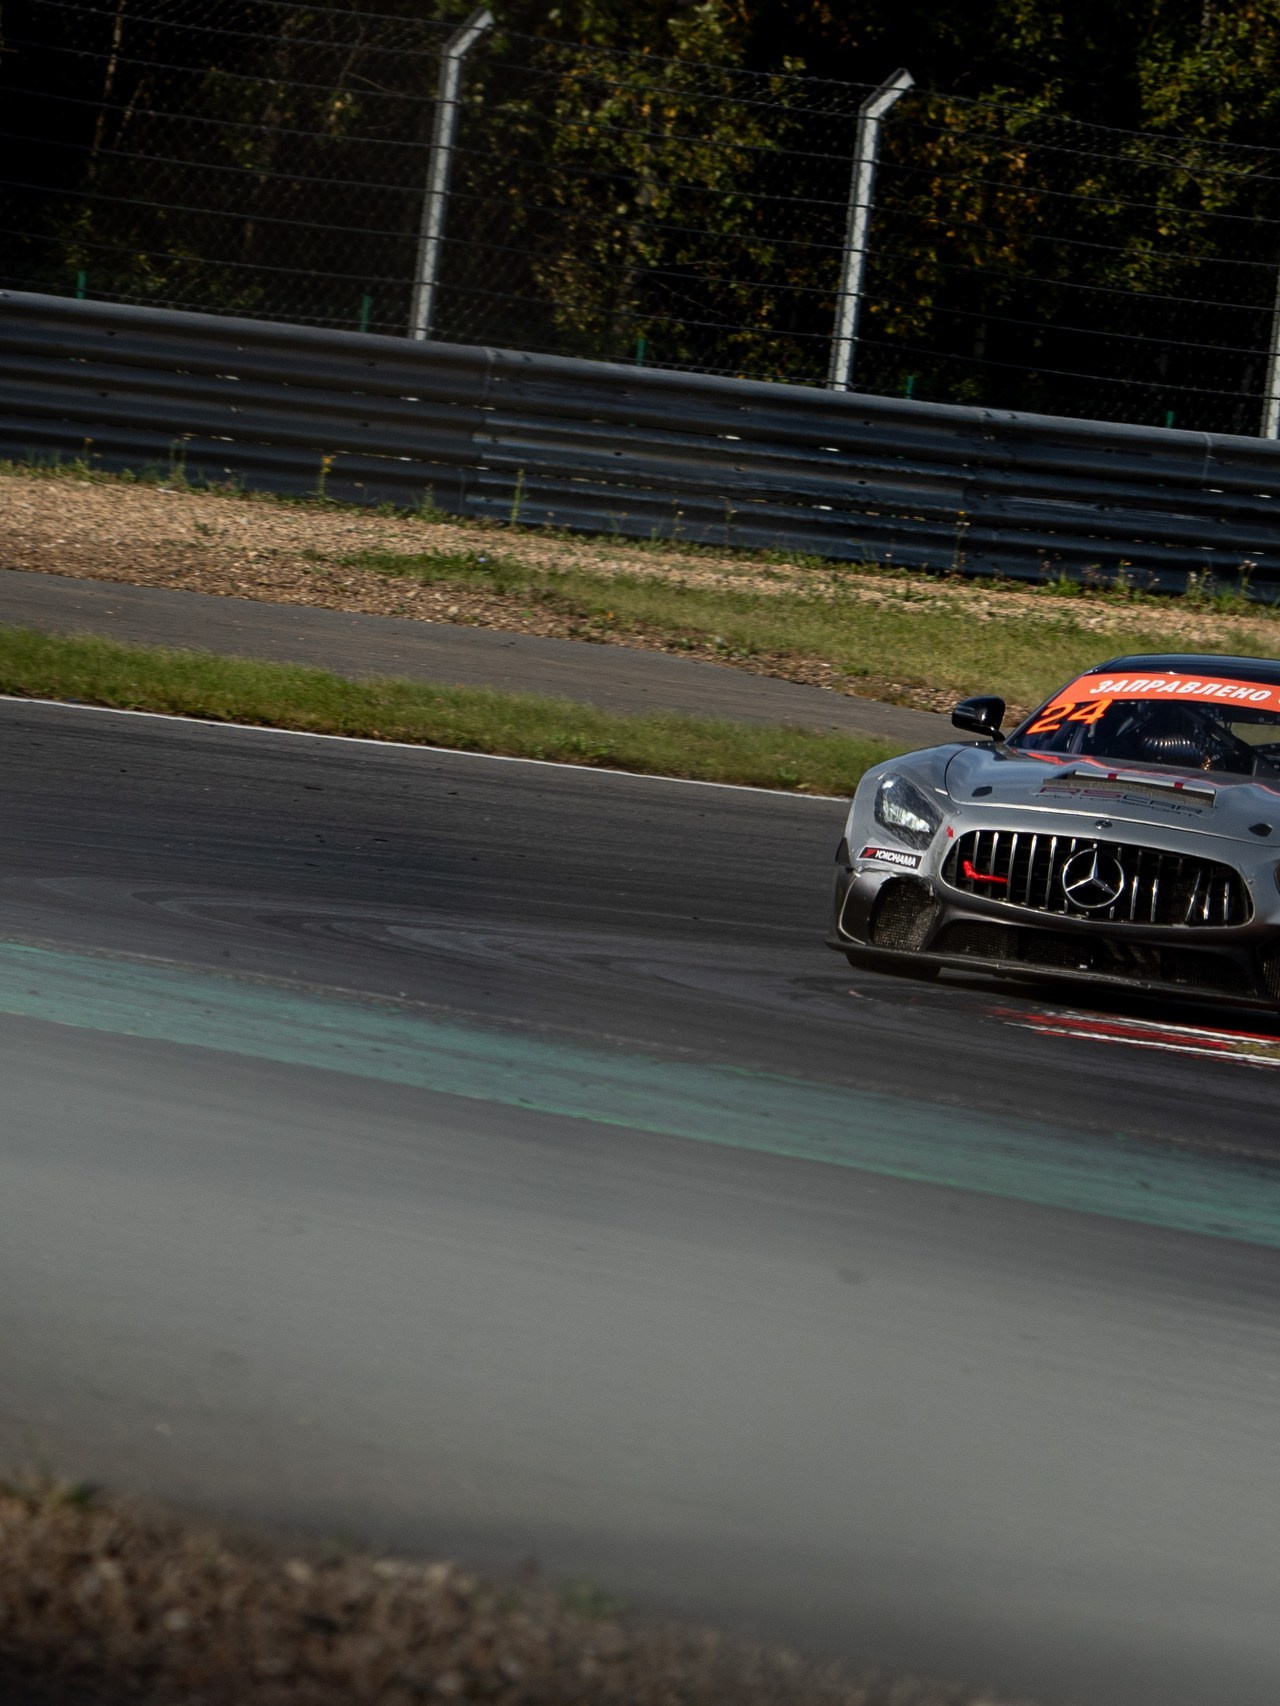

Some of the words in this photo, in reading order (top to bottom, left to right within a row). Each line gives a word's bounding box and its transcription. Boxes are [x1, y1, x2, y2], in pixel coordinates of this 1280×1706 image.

[1089, 680, 1272, 701] ЗАПРАВЛЕНО
[1026, 699, 1112, 734] 24
[875, 850, 916, 867] YOKOHAMA
